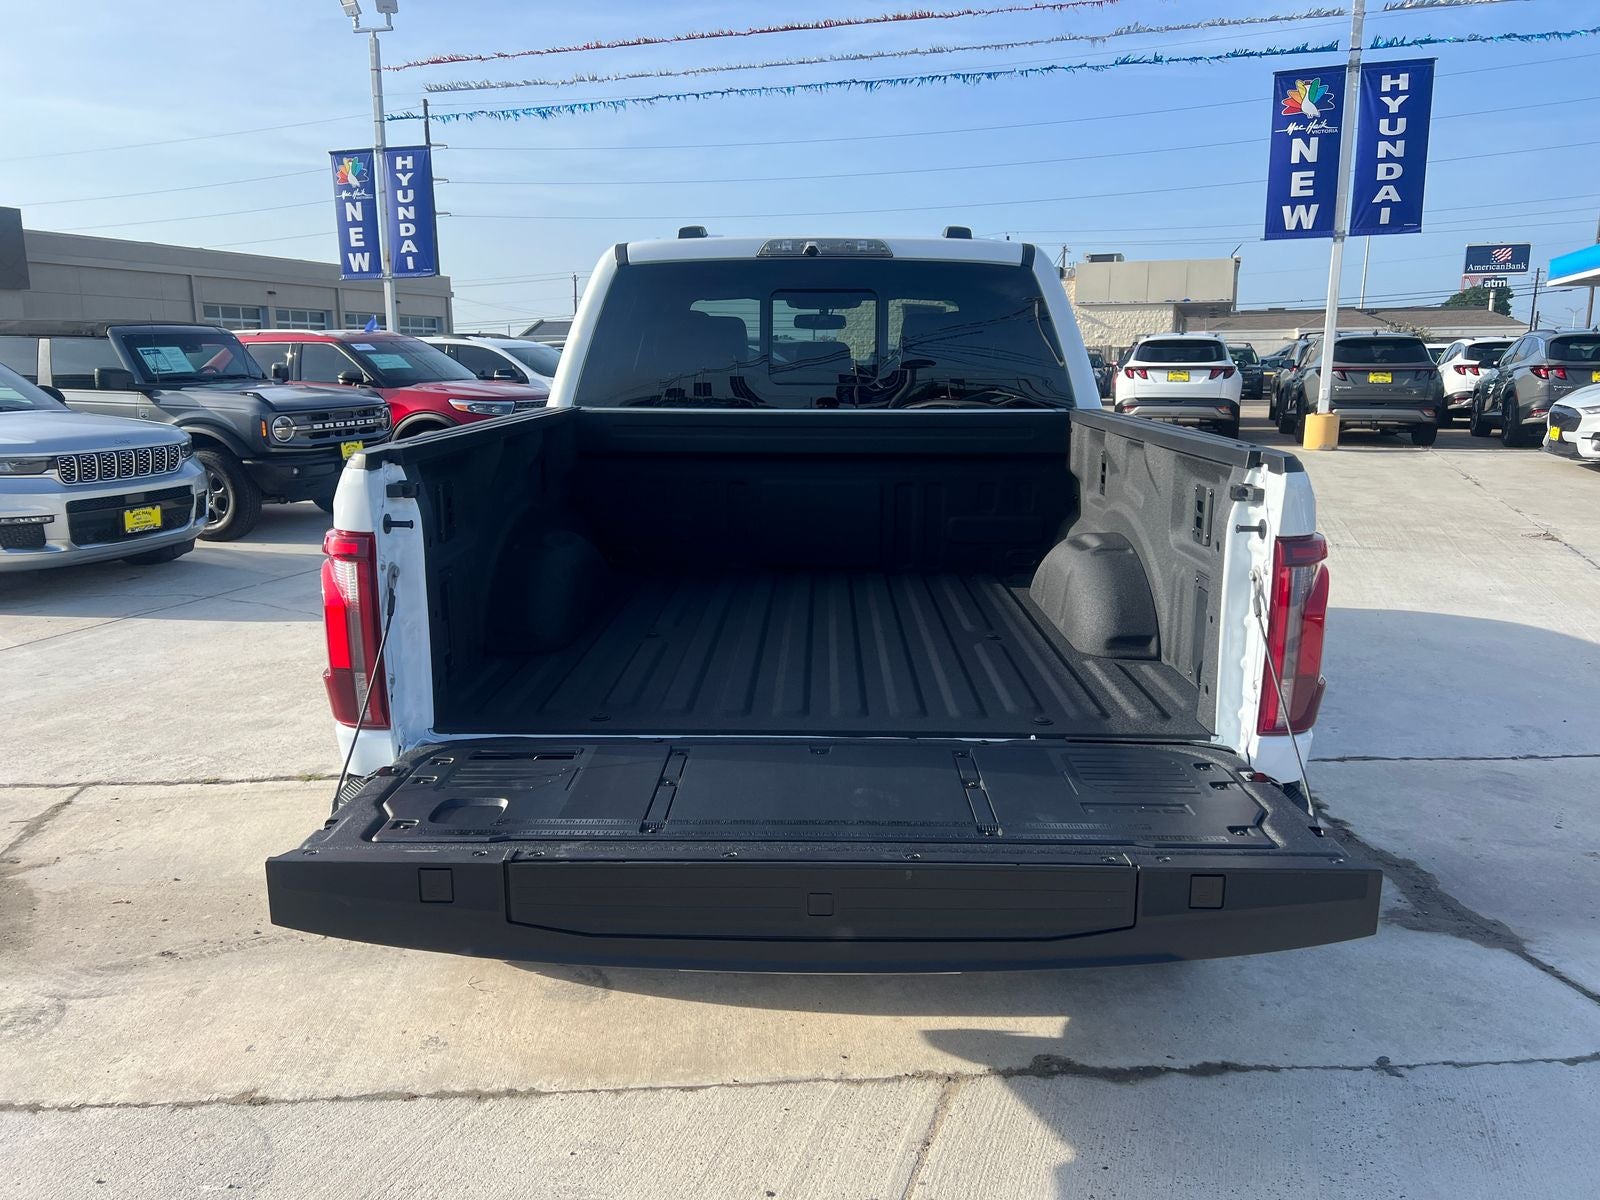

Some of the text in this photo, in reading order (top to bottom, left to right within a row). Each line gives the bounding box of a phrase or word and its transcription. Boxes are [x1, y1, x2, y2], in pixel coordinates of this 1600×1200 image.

[1278, 119, 1338, 136] Mac Haik
[1372, 73, 1410, 225] HYUNDAI
[1281, 136, 1320, 231] NEW
[395, 155, 419, 270] HYUNDAI
[345, 201, 370, 272] NEW
[1467, 262, 1527, 271] AmericanBank
[1484, 279, 1506, 288] atm
[312, 418, 375, 430] BRONCO
